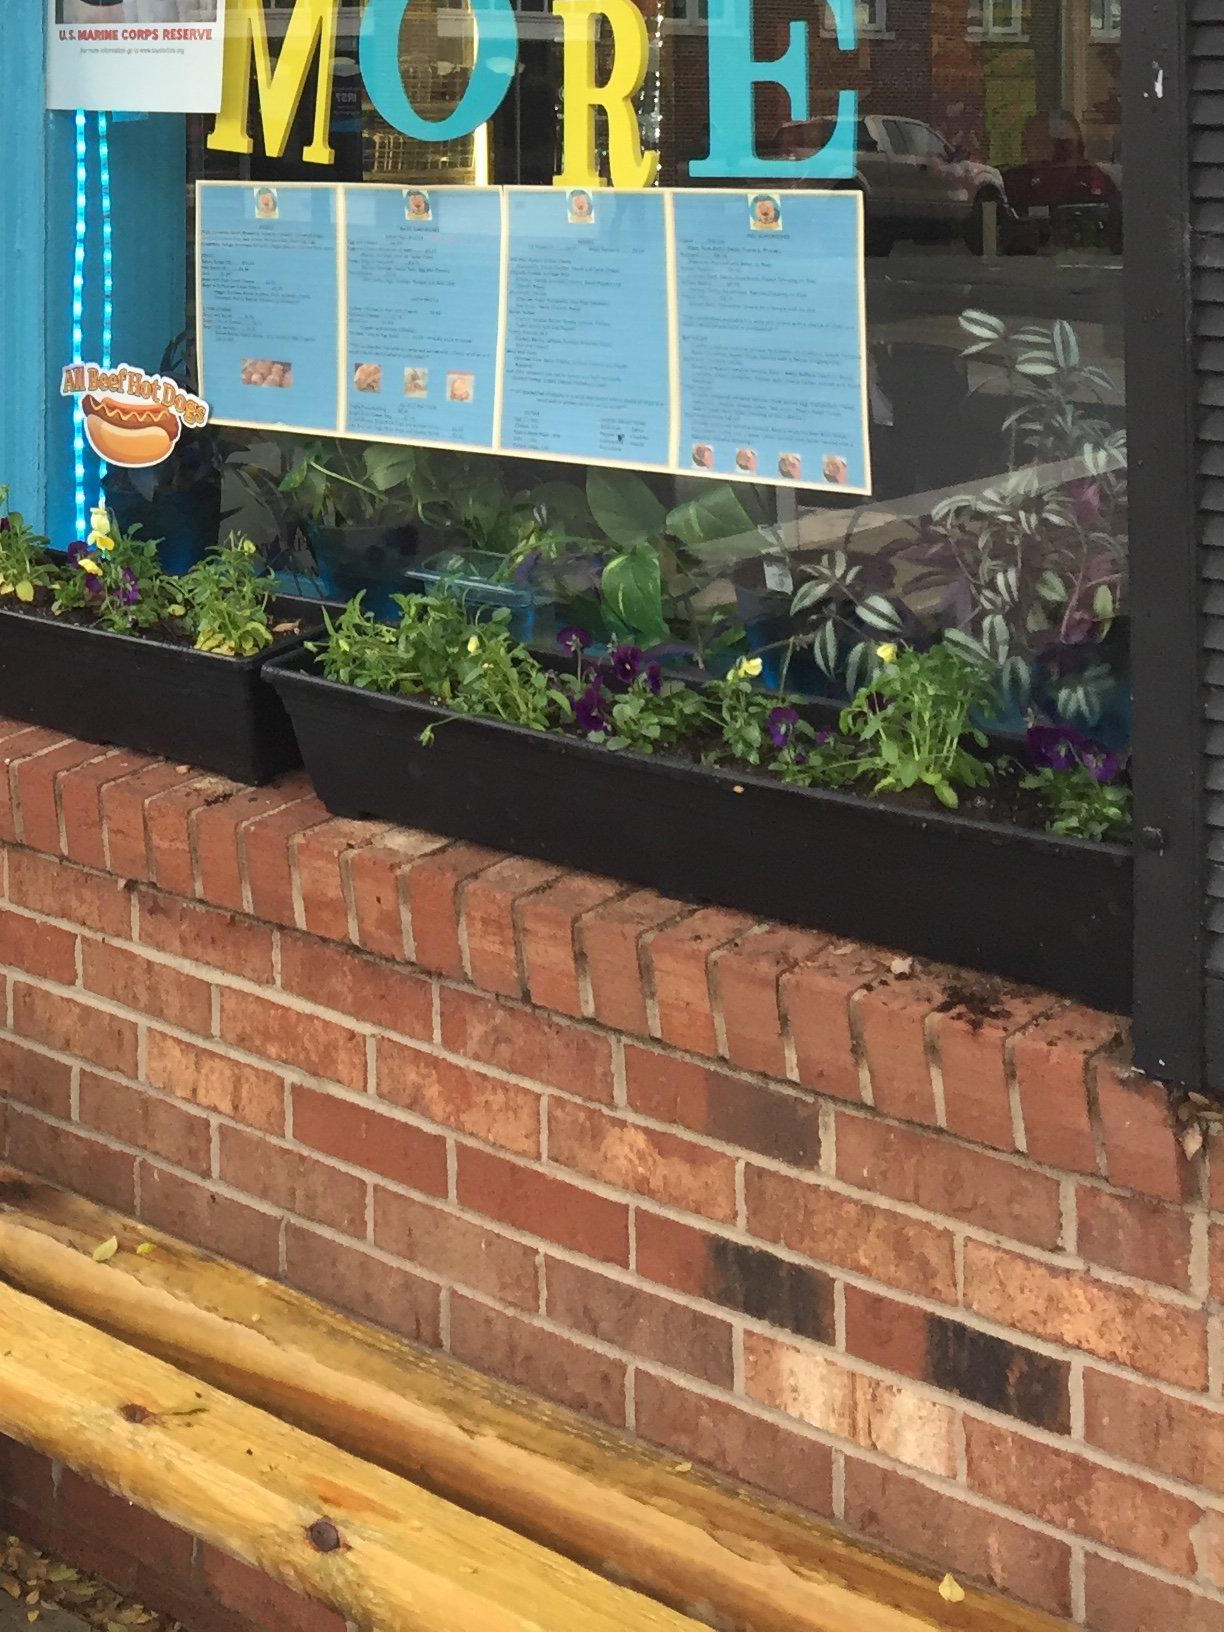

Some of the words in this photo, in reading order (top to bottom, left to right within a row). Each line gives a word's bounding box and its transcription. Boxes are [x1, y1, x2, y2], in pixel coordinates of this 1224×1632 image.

[77, 29, 119, 41] MARINE
[121, 28, 159, 41] CORPS
[162, 28, 213, 41] RESERVE
[87, 368, 127, 393] Beef
[127, 371, 161, 403] Hot
[161, 380, 206, 424] Dogs
